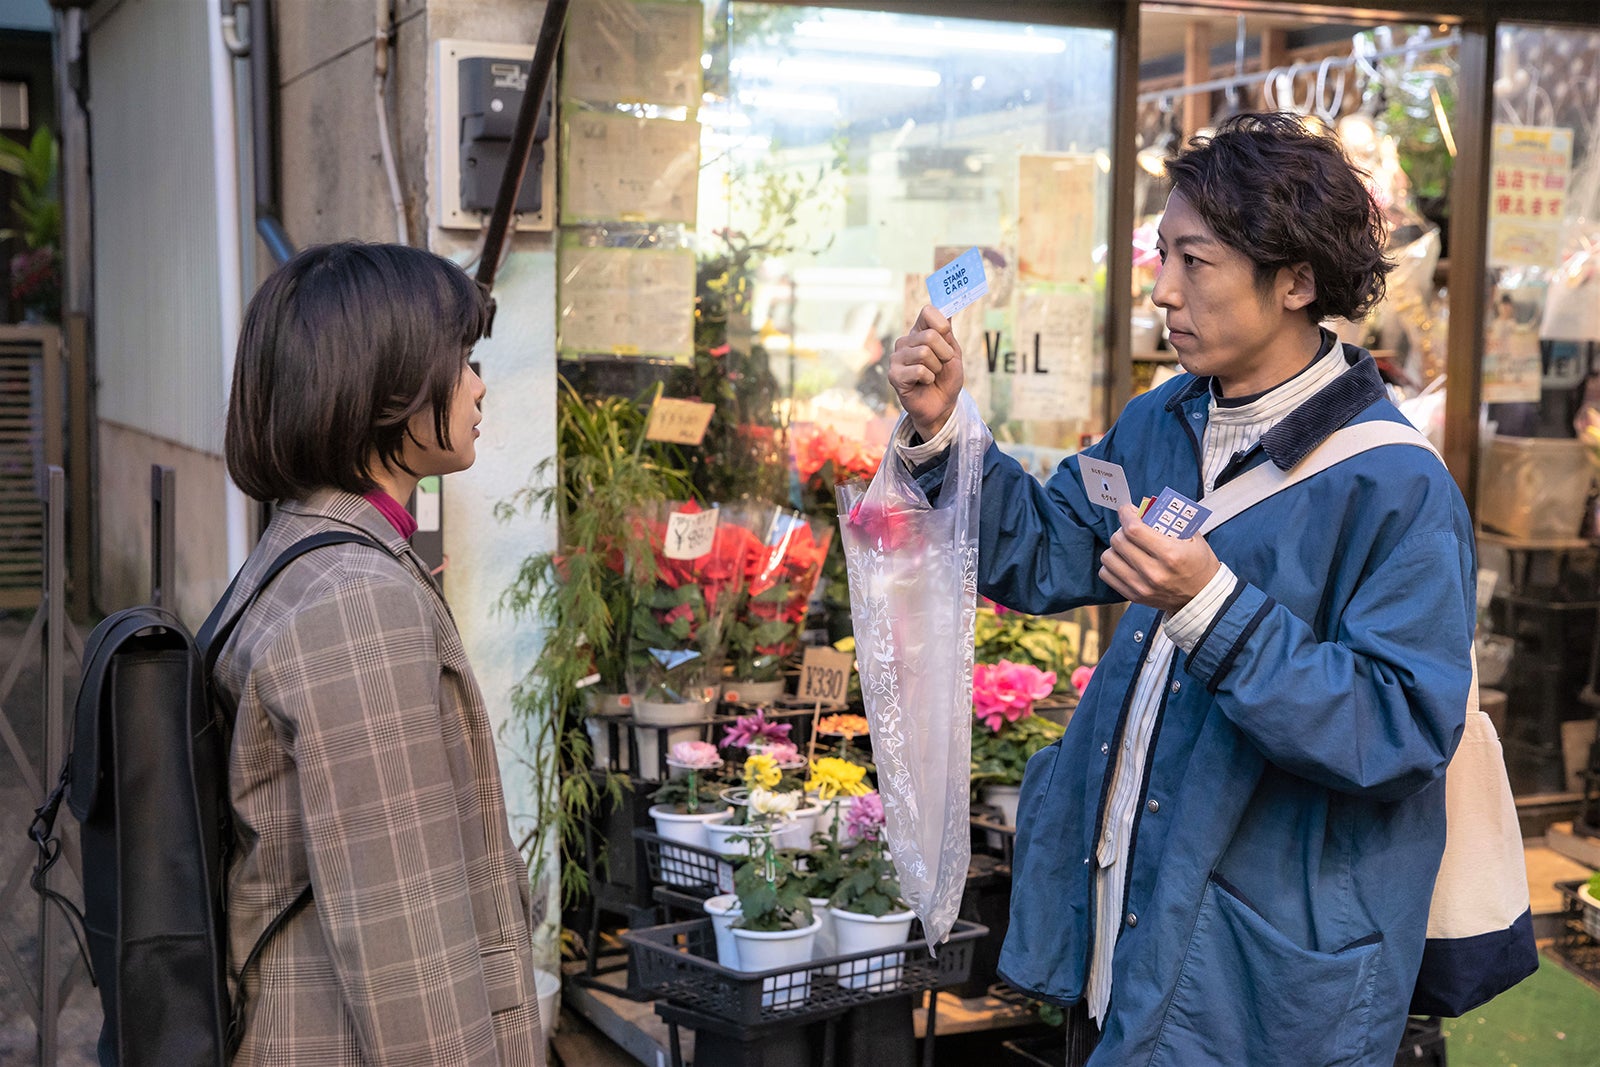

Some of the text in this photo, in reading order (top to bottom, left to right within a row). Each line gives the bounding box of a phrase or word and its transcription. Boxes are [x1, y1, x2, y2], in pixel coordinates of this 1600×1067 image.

[943, 268, 967, 287] STAMP
[945, 276, 969, 295] CARD
[1161, 502, 1179, 523] P P
[1175, 509, 1193, 530] P P
[806, 666, 843, 699] ¥330
